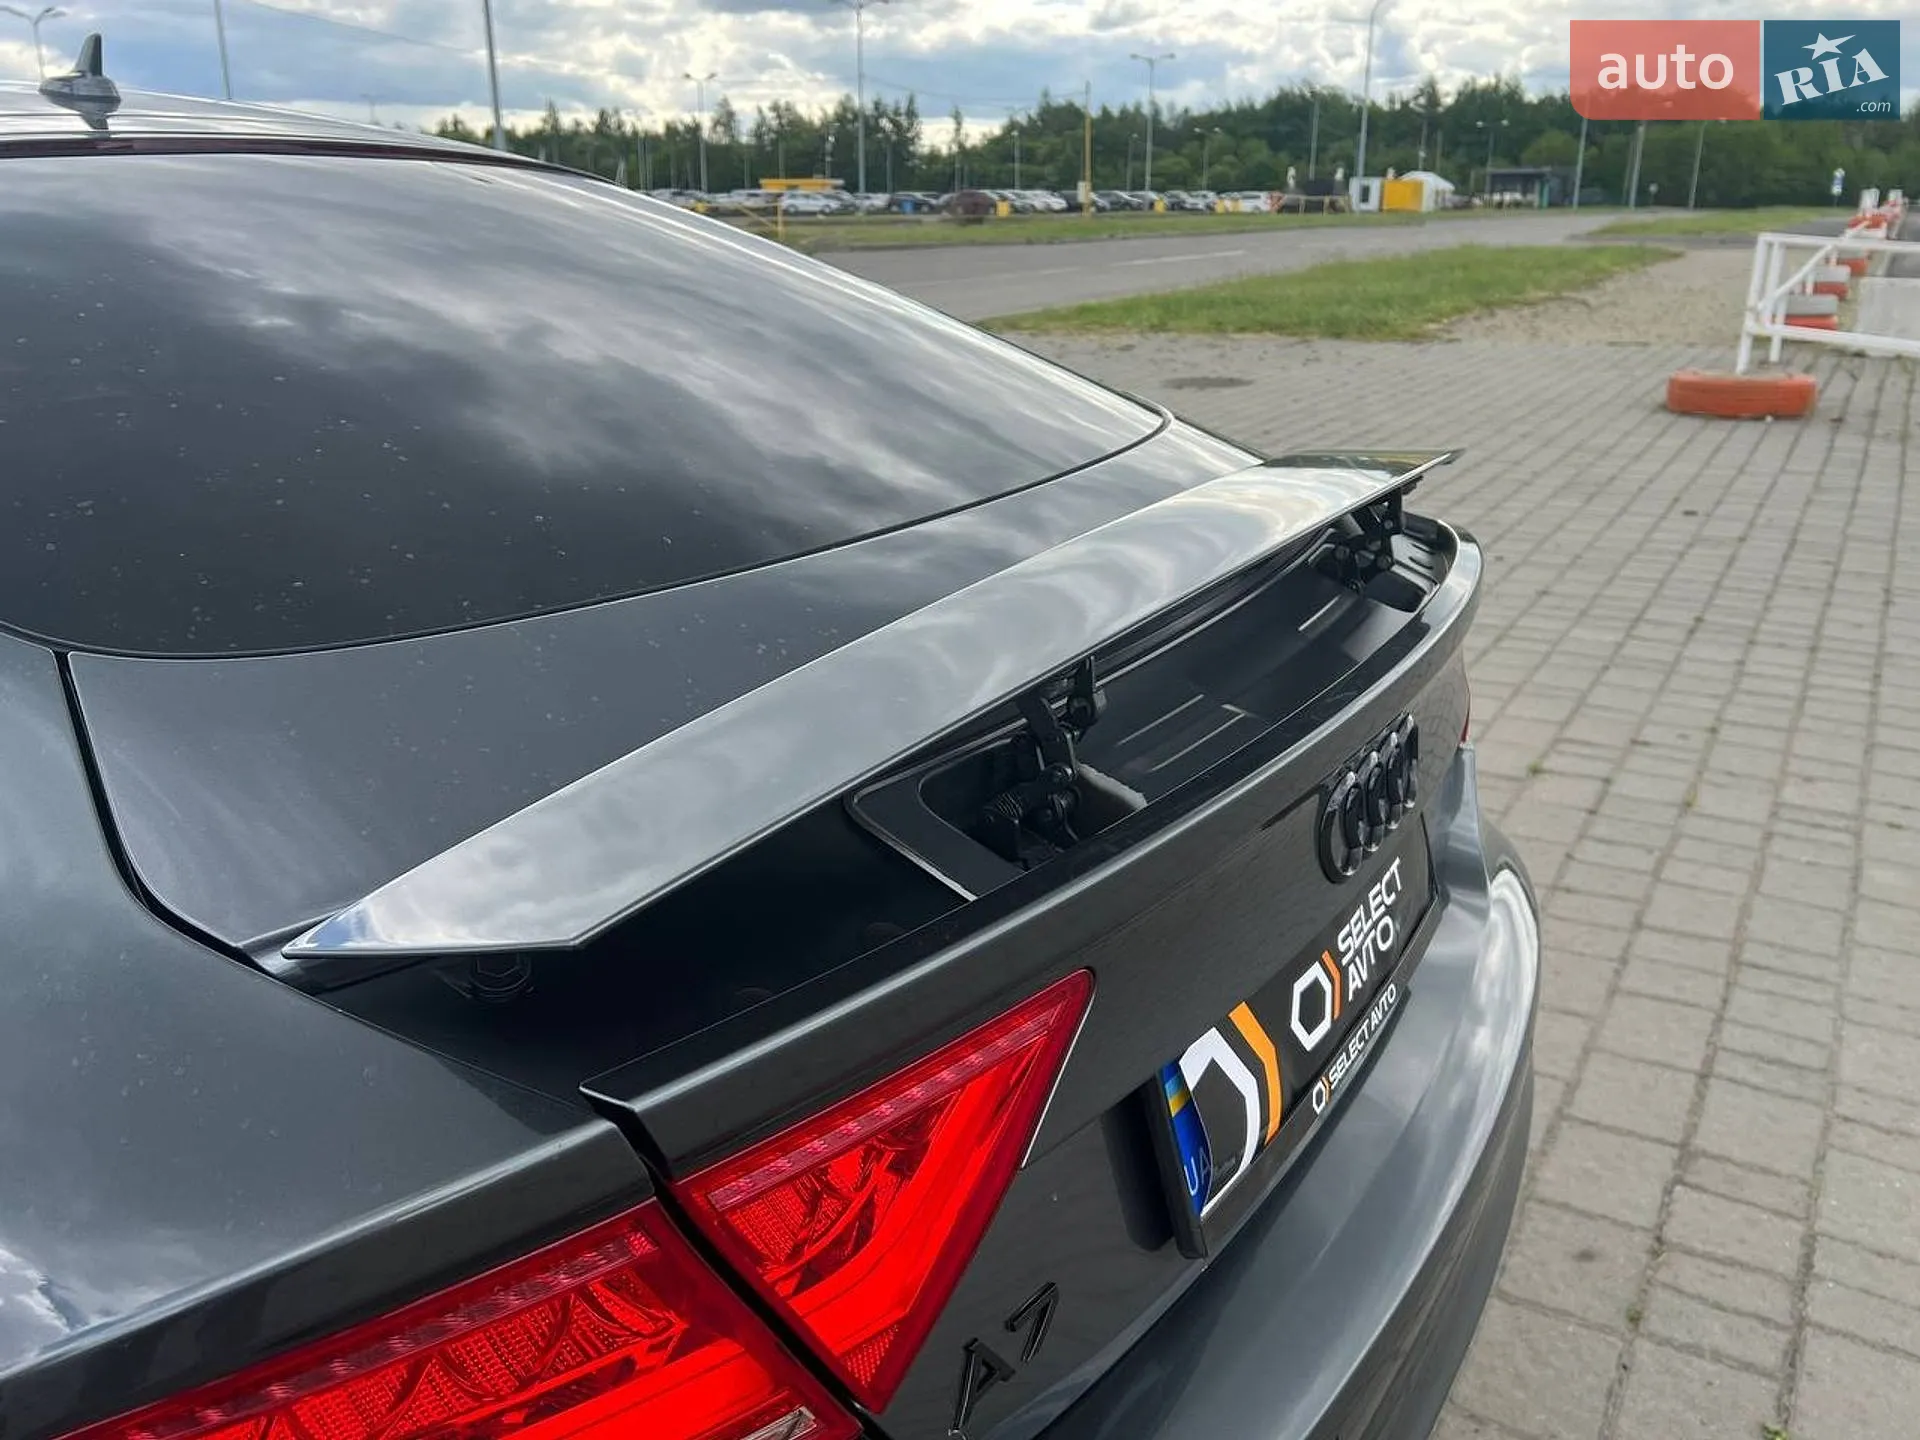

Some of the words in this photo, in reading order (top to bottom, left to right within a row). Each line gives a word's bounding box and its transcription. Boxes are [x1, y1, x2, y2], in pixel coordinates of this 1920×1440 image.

[1336, 857, 1403, 966] SELECT
[1347, 917, 1396, 1002] AVTO
[1329, 1019, 1371, 1090] SELECT
[1370, 983, 1397, 1031] AVTO
[952, 1281, 1060, 1430] A7
